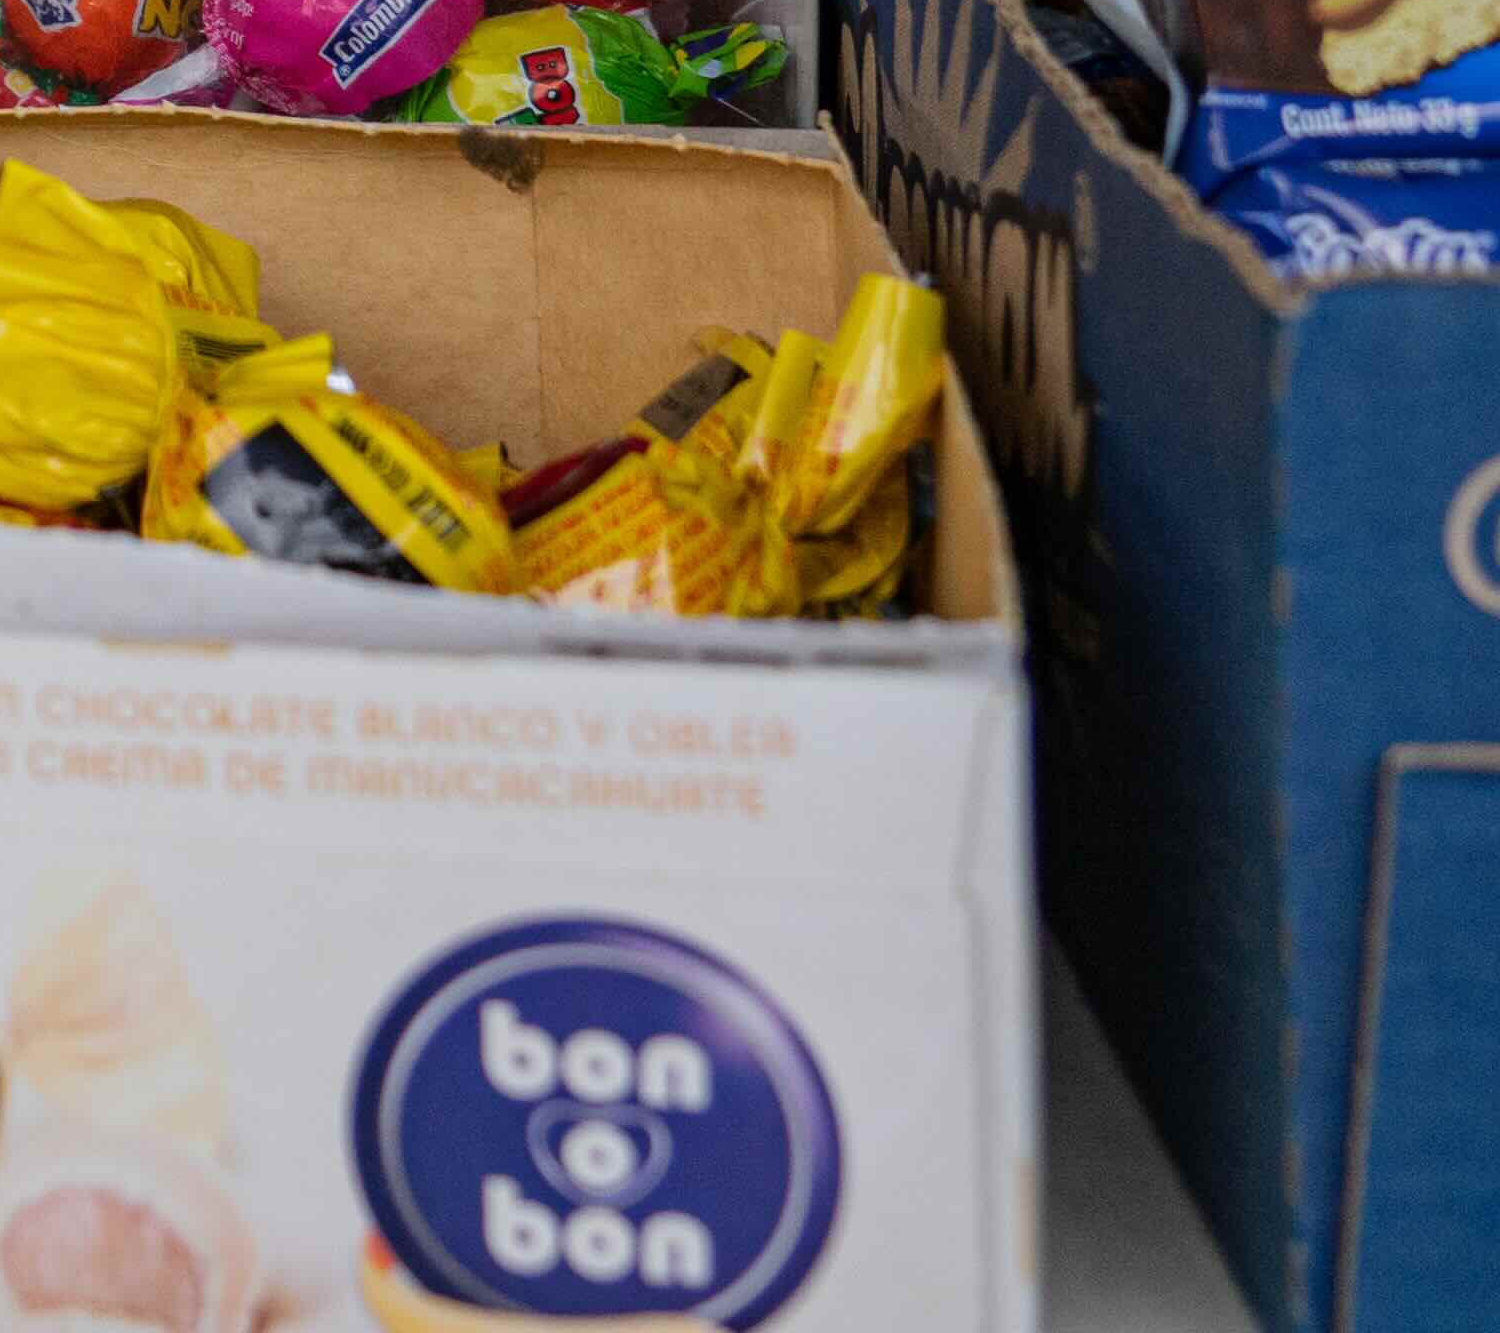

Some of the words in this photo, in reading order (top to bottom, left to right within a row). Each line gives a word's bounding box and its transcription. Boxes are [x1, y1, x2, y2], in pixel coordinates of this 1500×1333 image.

[35, 683, 336, 741] CHOCOLATE
[358, 701, 559, 754] BLANCO
[631, 712, 797, 761] OBLEA
[27, 738, 208, 790] CREMA
[226, 753, 290, 797] DE
[478, 996, 714, 1113] bon
[560, 1118, 634, 1186] o
[480, 1175, 714, 1290] bon
